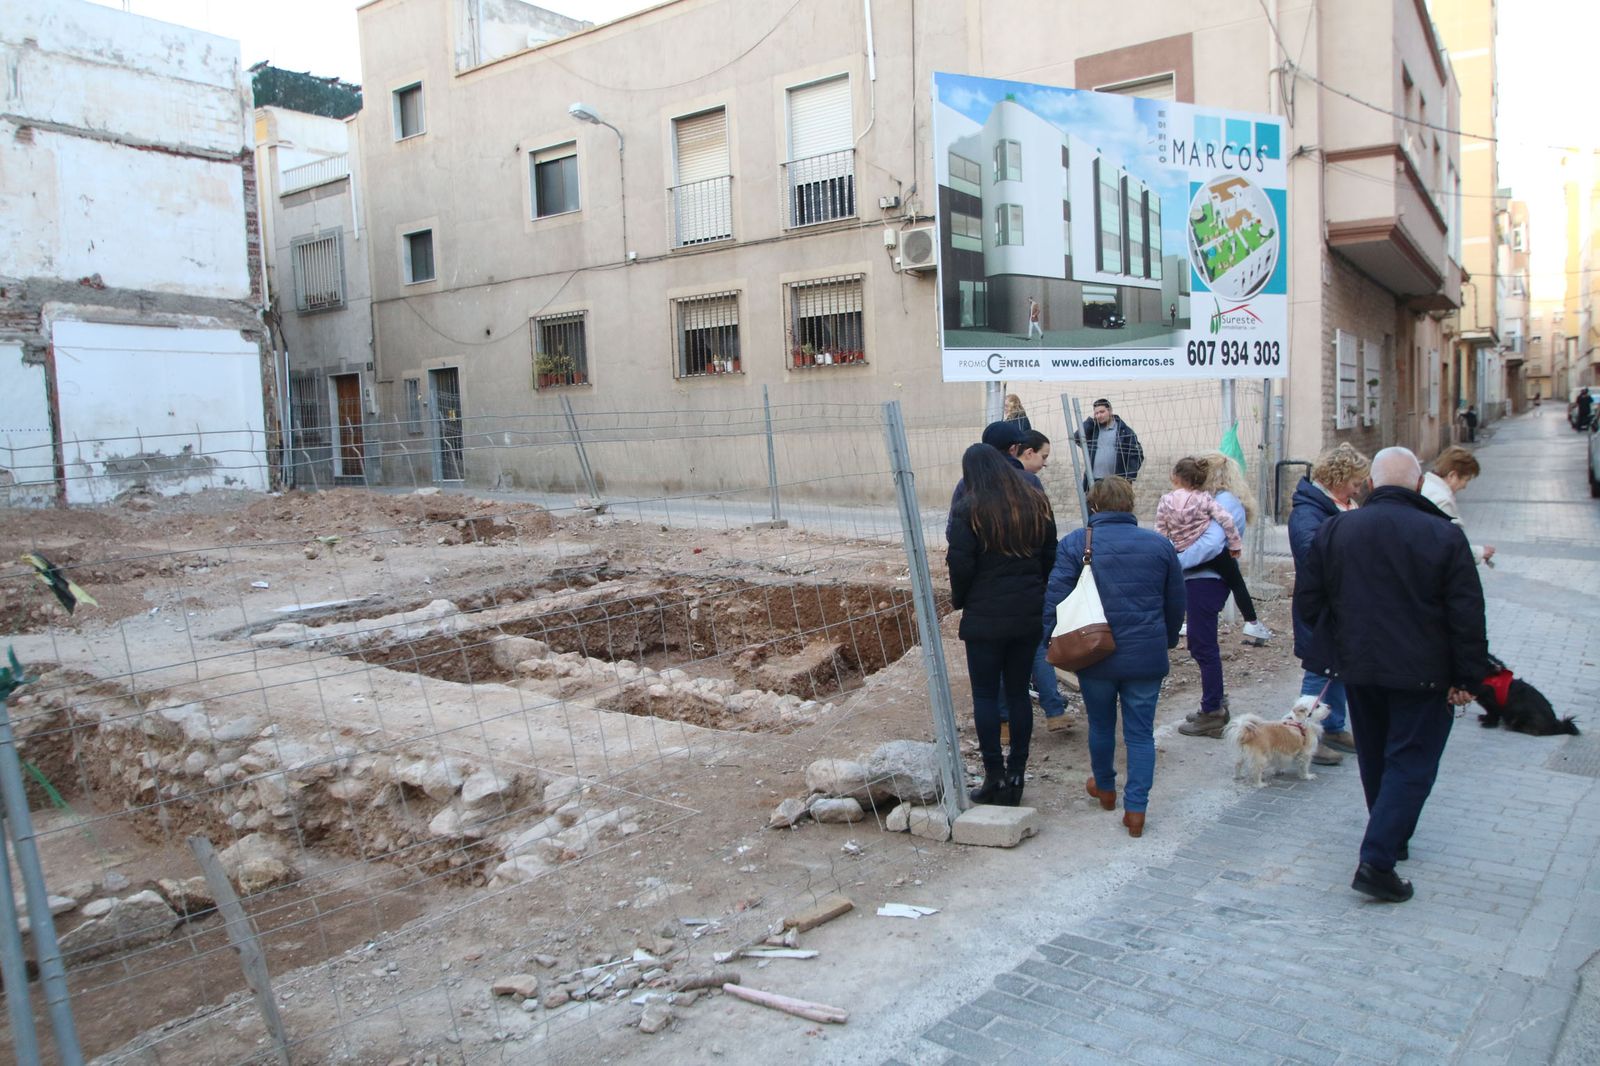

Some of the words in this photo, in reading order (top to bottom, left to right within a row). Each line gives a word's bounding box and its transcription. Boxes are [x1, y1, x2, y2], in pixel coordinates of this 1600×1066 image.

[1173, 138, 1265, 173] MARCOS
[1221, 315, 1256, 325] Sureste
[1051, 357, 1175, 367] www.edificiomarcos.es
[1187, 340, 1216, 366] 607
[1221, 340, 1249, 366] 934
[1254, 340, 1280, 366] 303
